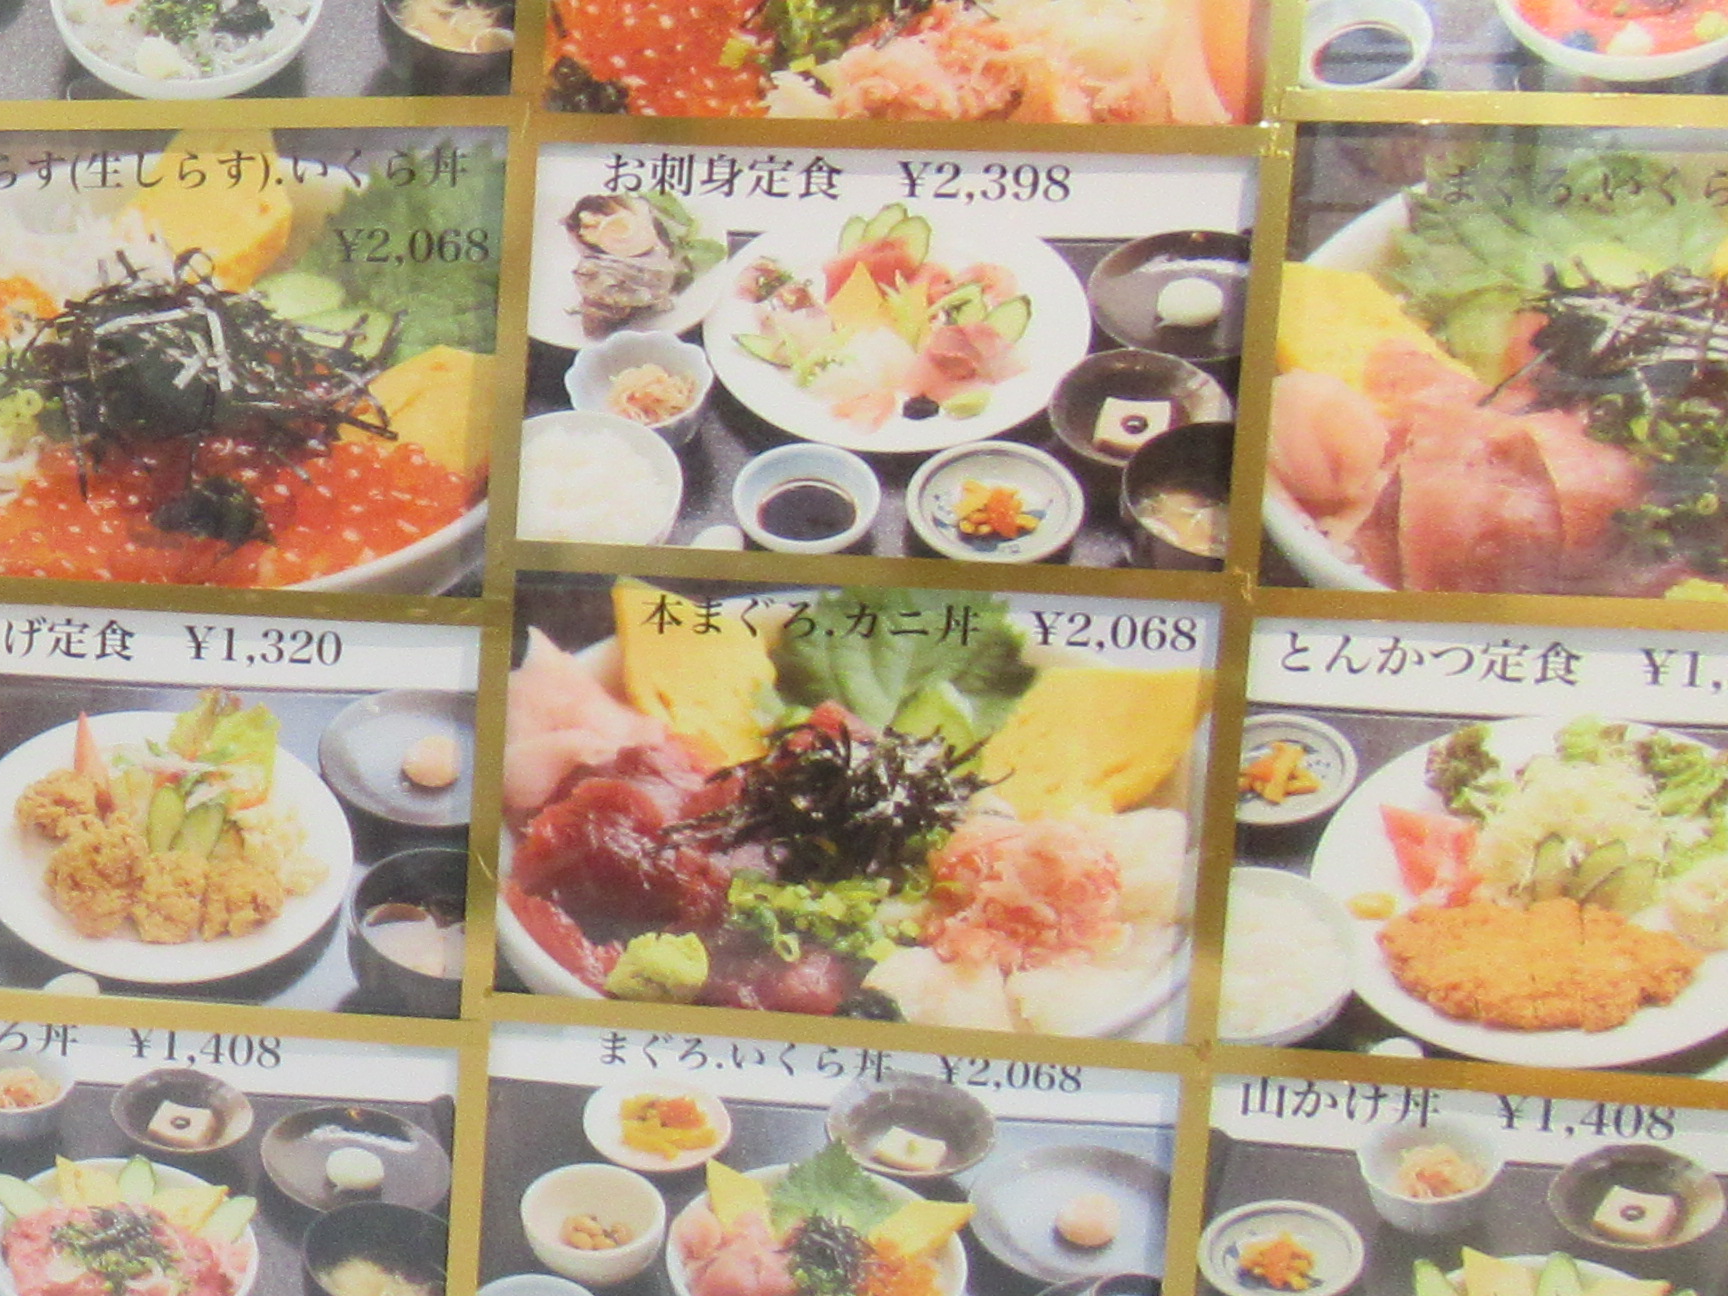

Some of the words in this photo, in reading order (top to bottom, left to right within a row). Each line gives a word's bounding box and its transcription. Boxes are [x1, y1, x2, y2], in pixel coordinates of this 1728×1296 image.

[602, 152, 844, 200] お刺身定食
[898, 159, 1072, 203] ¥2,398
[336, 225, 490, 264] ¥2,068
[183, 622, 344, 669] ¥1,320
[1031, 608, 1199, 655] ¥2,068
[1278, 629, 1582, 688] とんかつ定食
[127, 1027, 283, 1069] ¥1,408
[939, 1054, 1084, 1094] ¥2,068
[1240, 1078, 1443, 1129] 山かけ丼
[1497, 1093, 1677, 1142] ¥1,408
